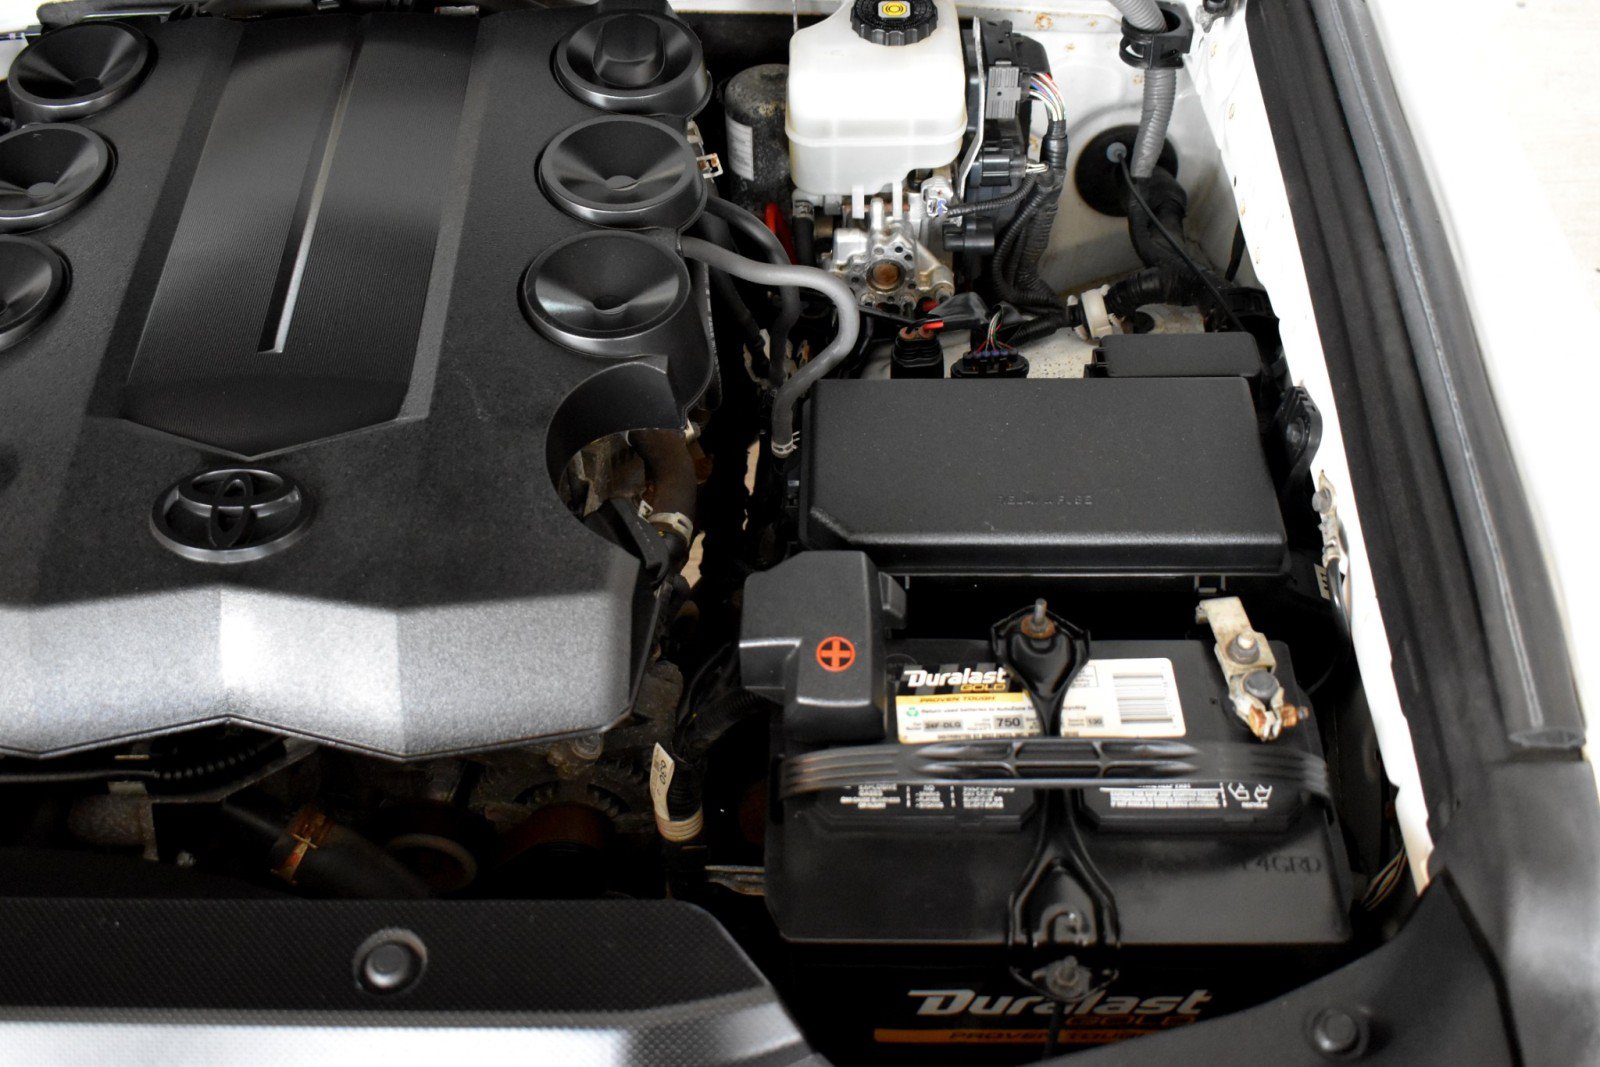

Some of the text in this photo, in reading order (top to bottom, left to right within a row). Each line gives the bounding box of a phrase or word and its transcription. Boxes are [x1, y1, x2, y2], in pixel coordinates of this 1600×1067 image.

[904, 667, 1007, 688] Duralast
[959, 683, 1006, 692] GOLD
[997, 717, 1021, 728] 750
[908, 989, 1212, 1016] Duralast
